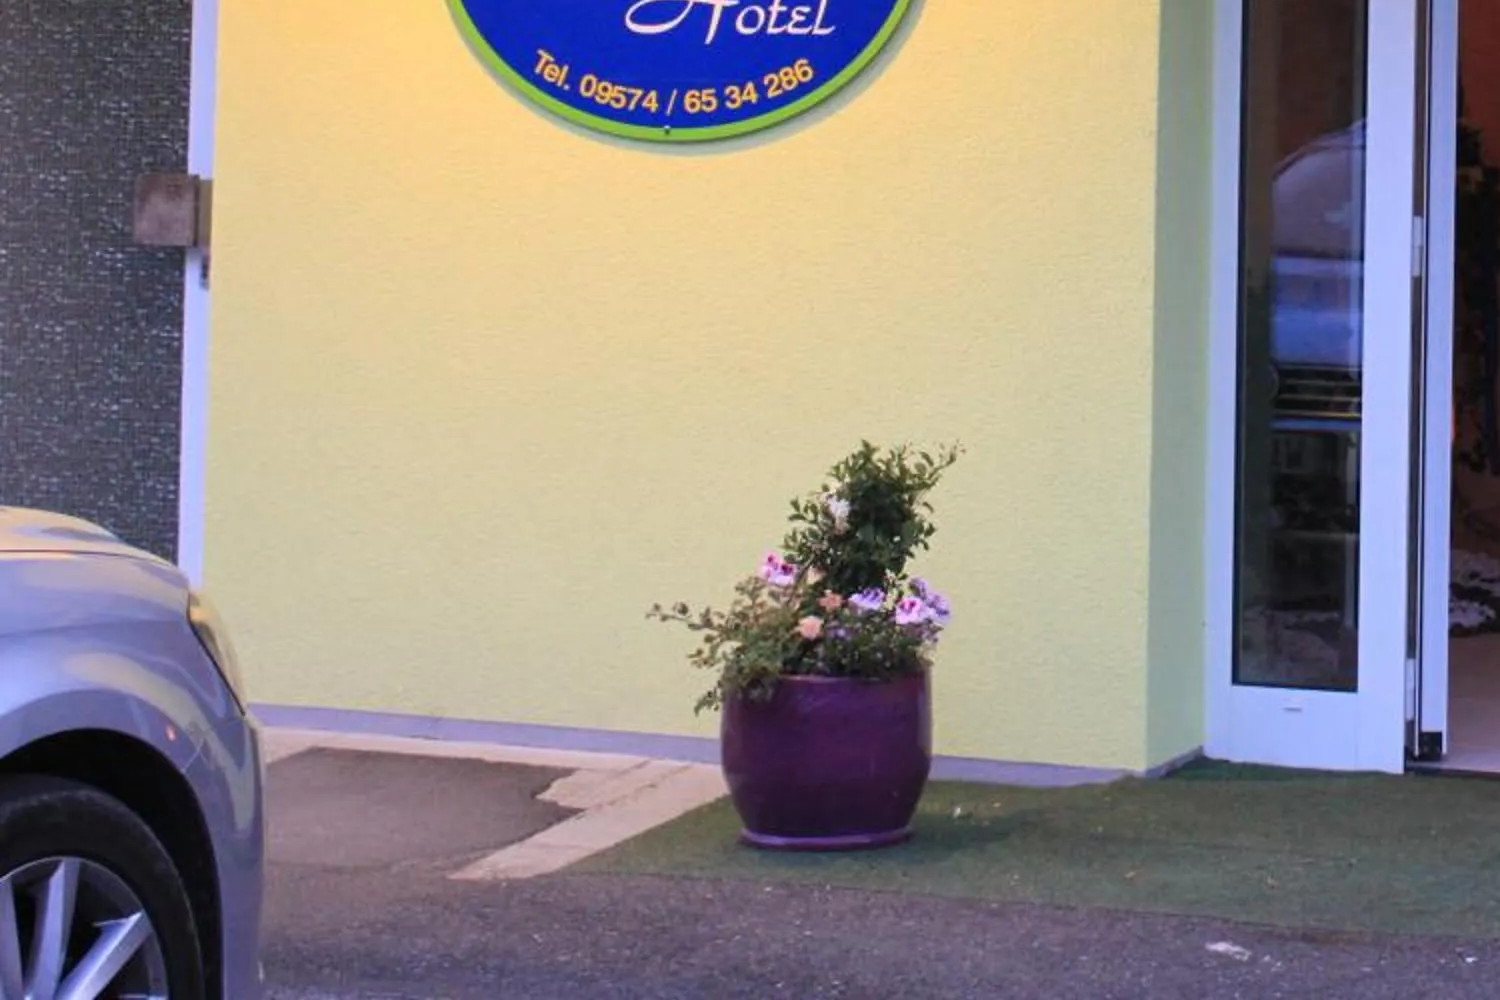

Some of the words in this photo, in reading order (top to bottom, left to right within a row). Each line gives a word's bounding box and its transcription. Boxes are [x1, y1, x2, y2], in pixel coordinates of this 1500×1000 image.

[533, 49, 570, 91] Tel.
[579, 73, 659, 113] 09574
[666, 88, 679, 116] /
[683, 88, 718, 114] 65
[724, 82, 759, 109] 34
[763, 58, 814, 99] 286
